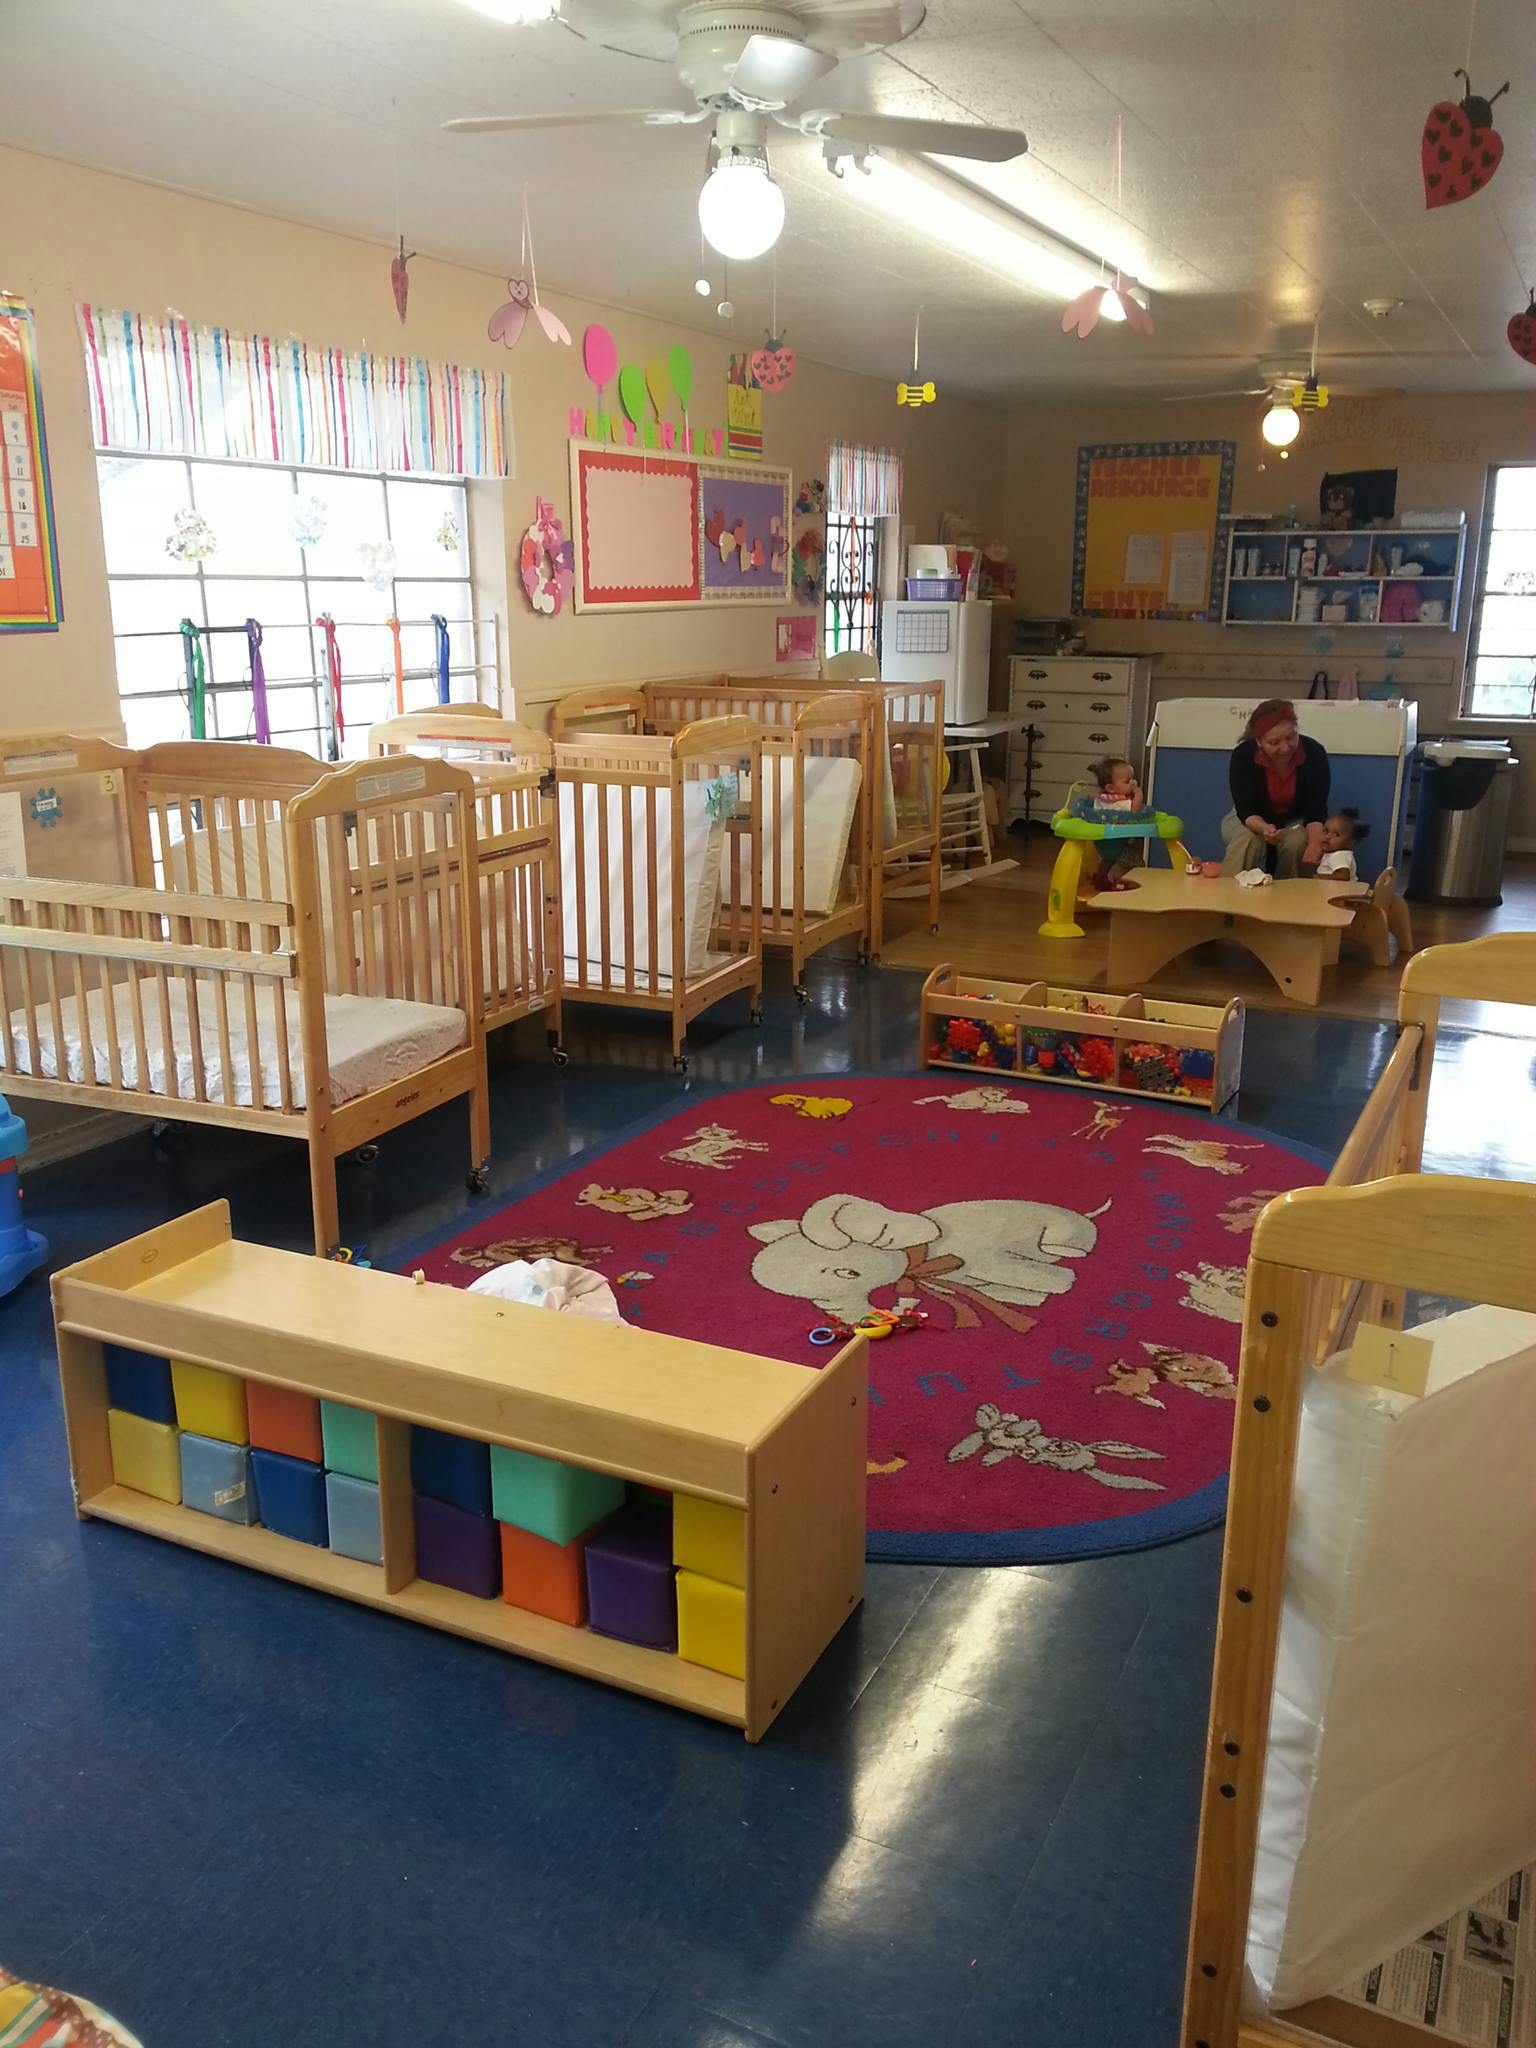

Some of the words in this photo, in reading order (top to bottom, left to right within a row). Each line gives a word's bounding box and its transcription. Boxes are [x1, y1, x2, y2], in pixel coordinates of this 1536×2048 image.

[568, 405, 636, 446] HAPPY
[1093, 456, 1200, 477] TEACHER
[1090, 477, 1210, 498] RESOURCE
[1087, 590, 1180, 610] CENTE
[520, 758, 529, 771] 4
[104, 775, 114, 792] 3
[1081, 1317, 1131, 1341] R
[1049, 1346, 1095, 1373] S
